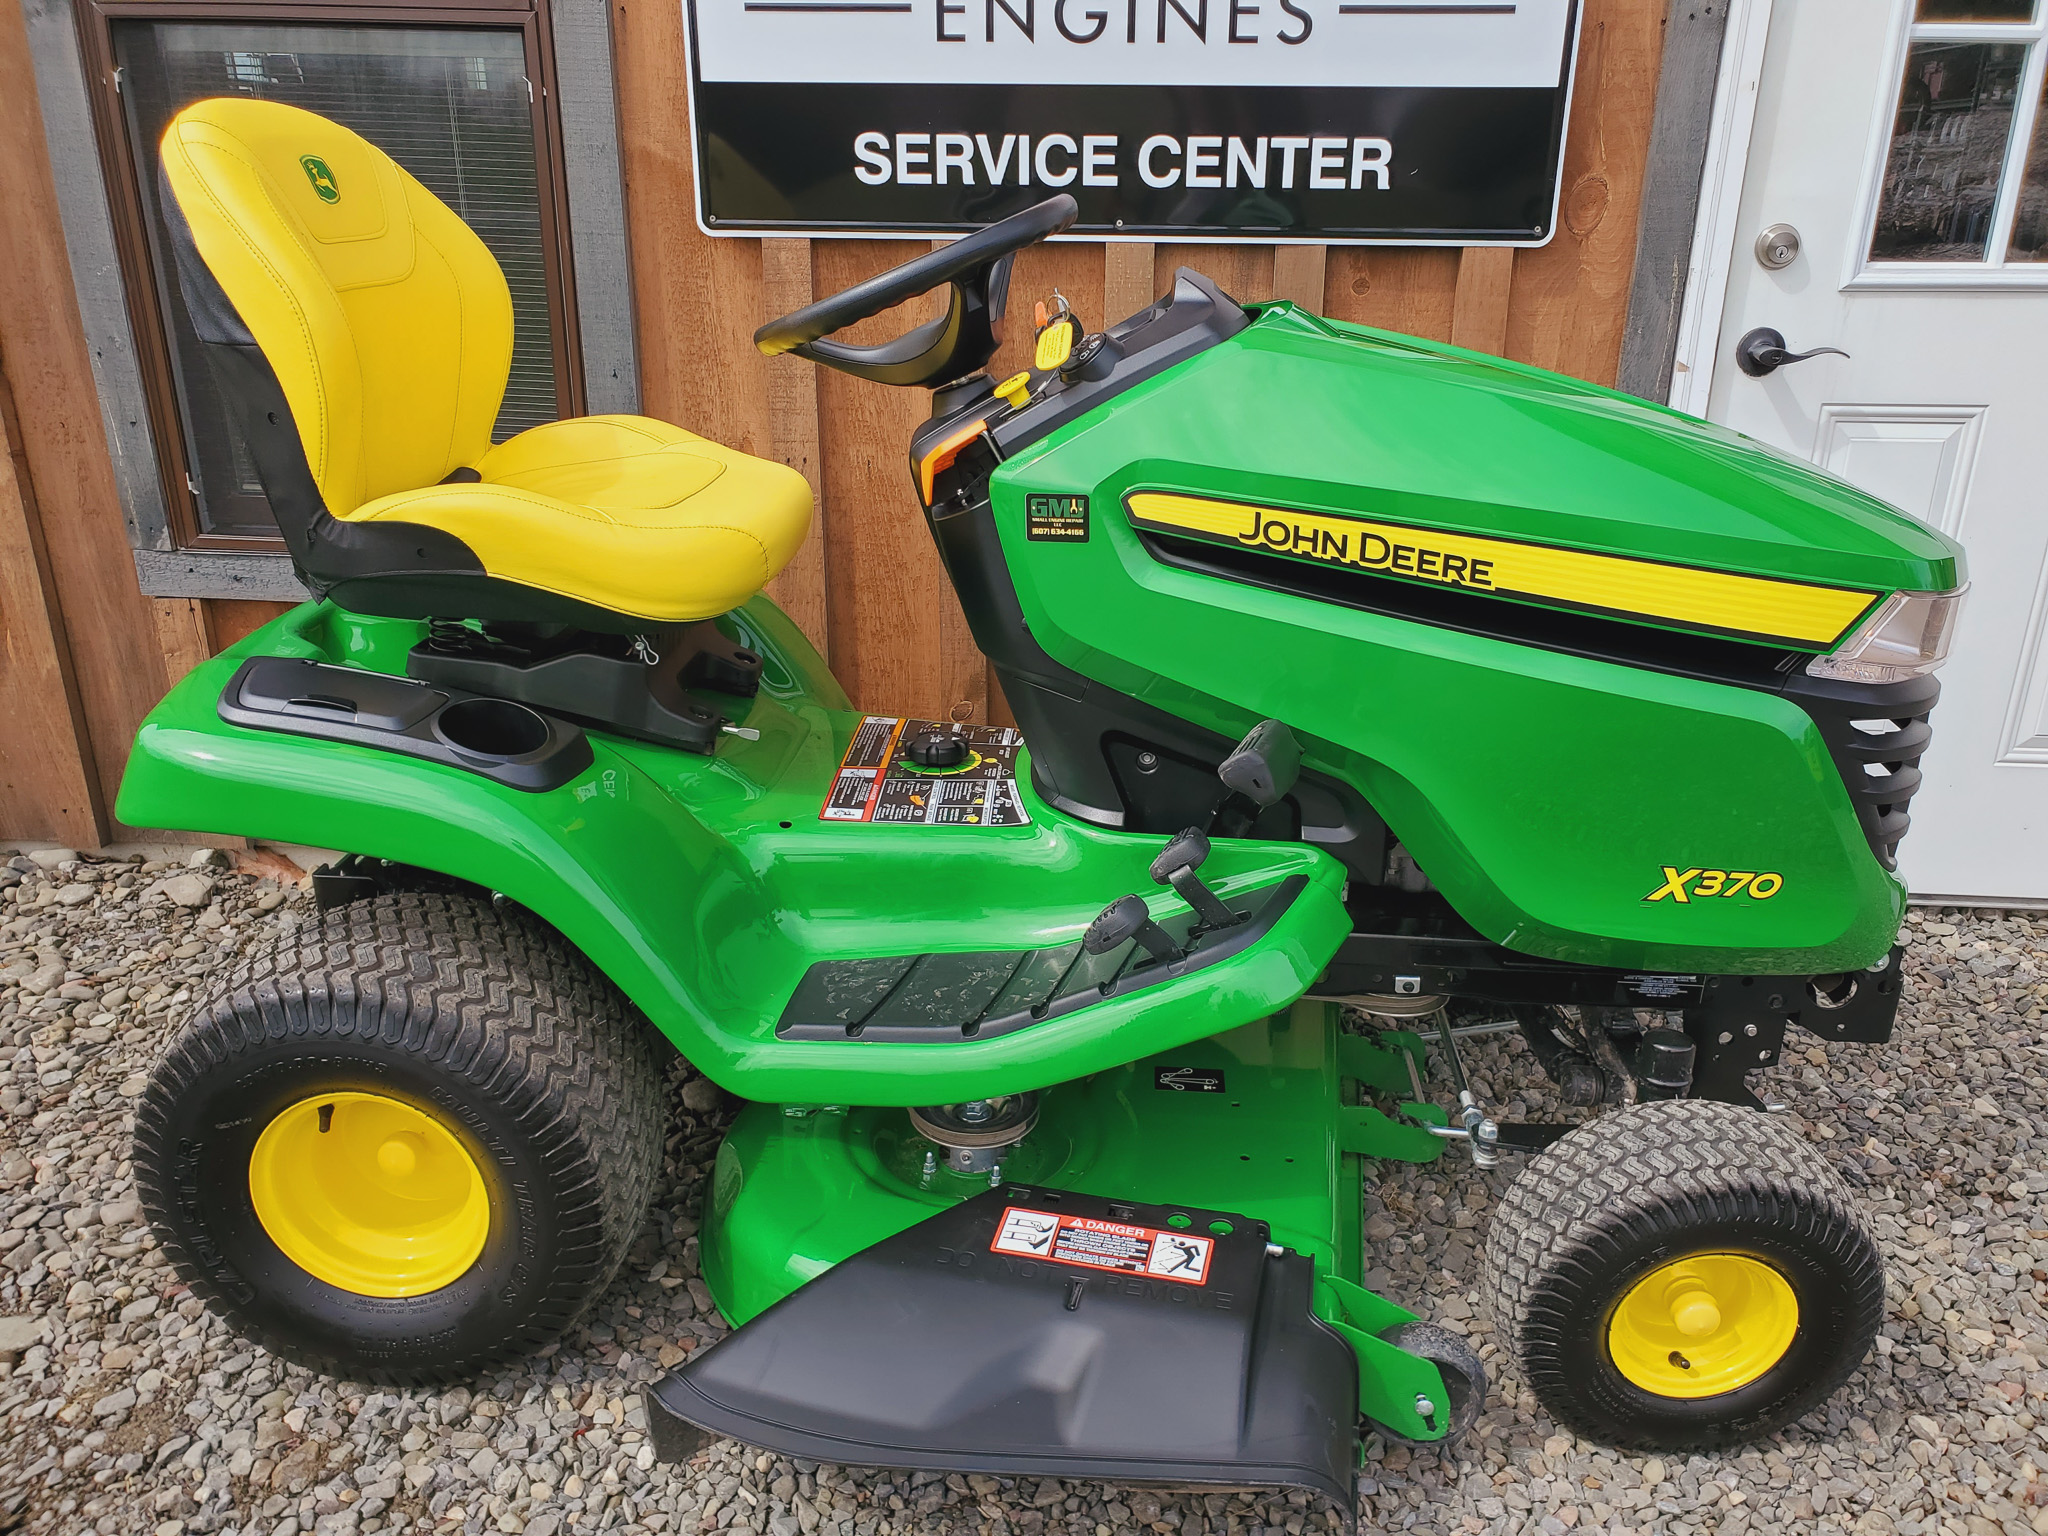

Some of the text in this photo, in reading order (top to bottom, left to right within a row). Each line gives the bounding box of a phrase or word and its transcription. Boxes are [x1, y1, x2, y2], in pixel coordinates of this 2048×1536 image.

[936, 0, 1313, 45] ENGINES
[853, 131, 1394, 191] SERVICE CENTER
[1238, 511, 1494, 586] JOHN DEERE
[1642, 865, 1785, 904] X370
[1085, 1220, 1146, 1237] DANGER
